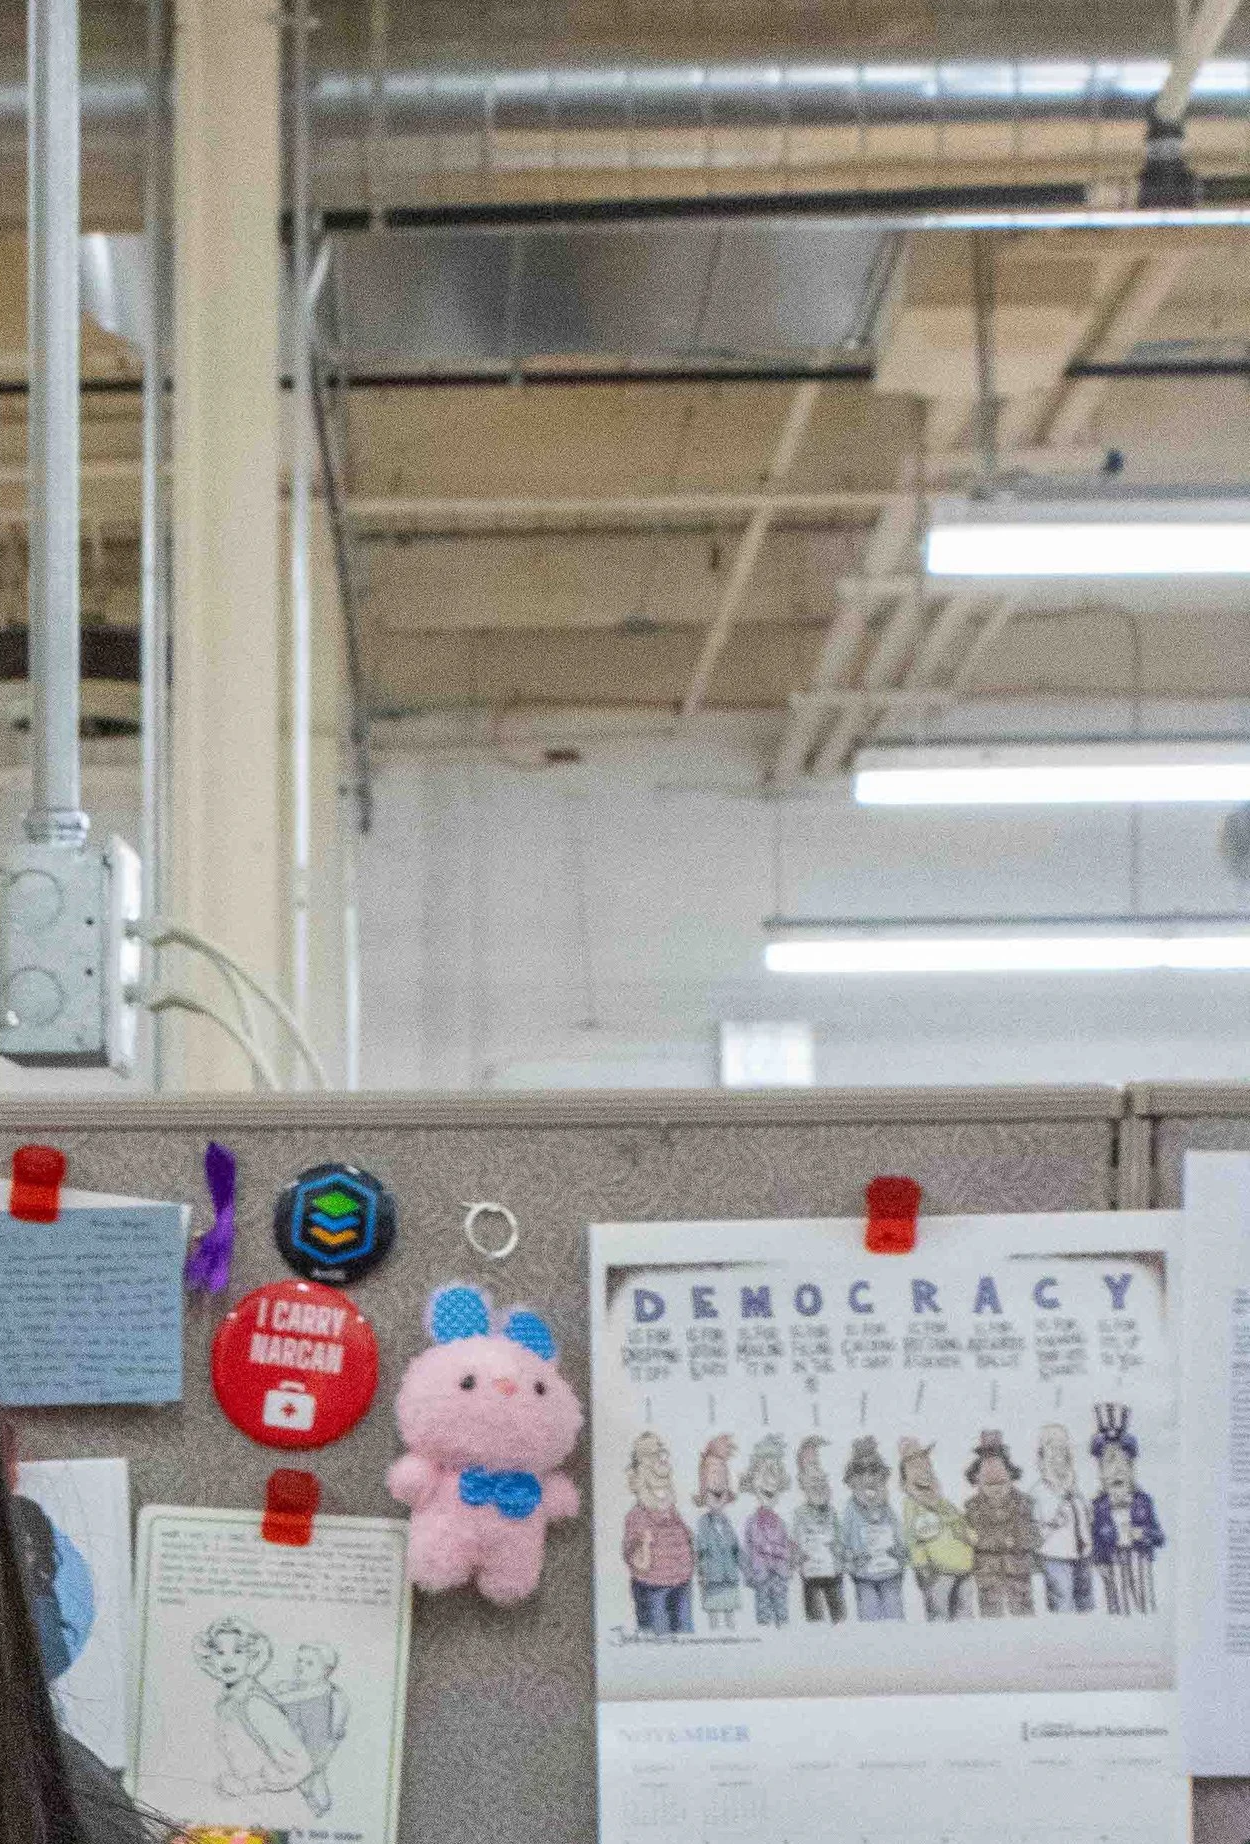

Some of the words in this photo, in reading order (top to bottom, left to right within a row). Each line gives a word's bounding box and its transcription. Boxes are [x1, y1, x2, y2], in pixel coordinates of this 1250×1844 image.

[256, 1297, 269, 1329] I
[272, 1300, 348, 1338] CARRY
[633, 1272, 1133, 1324] DEMOCRACY
